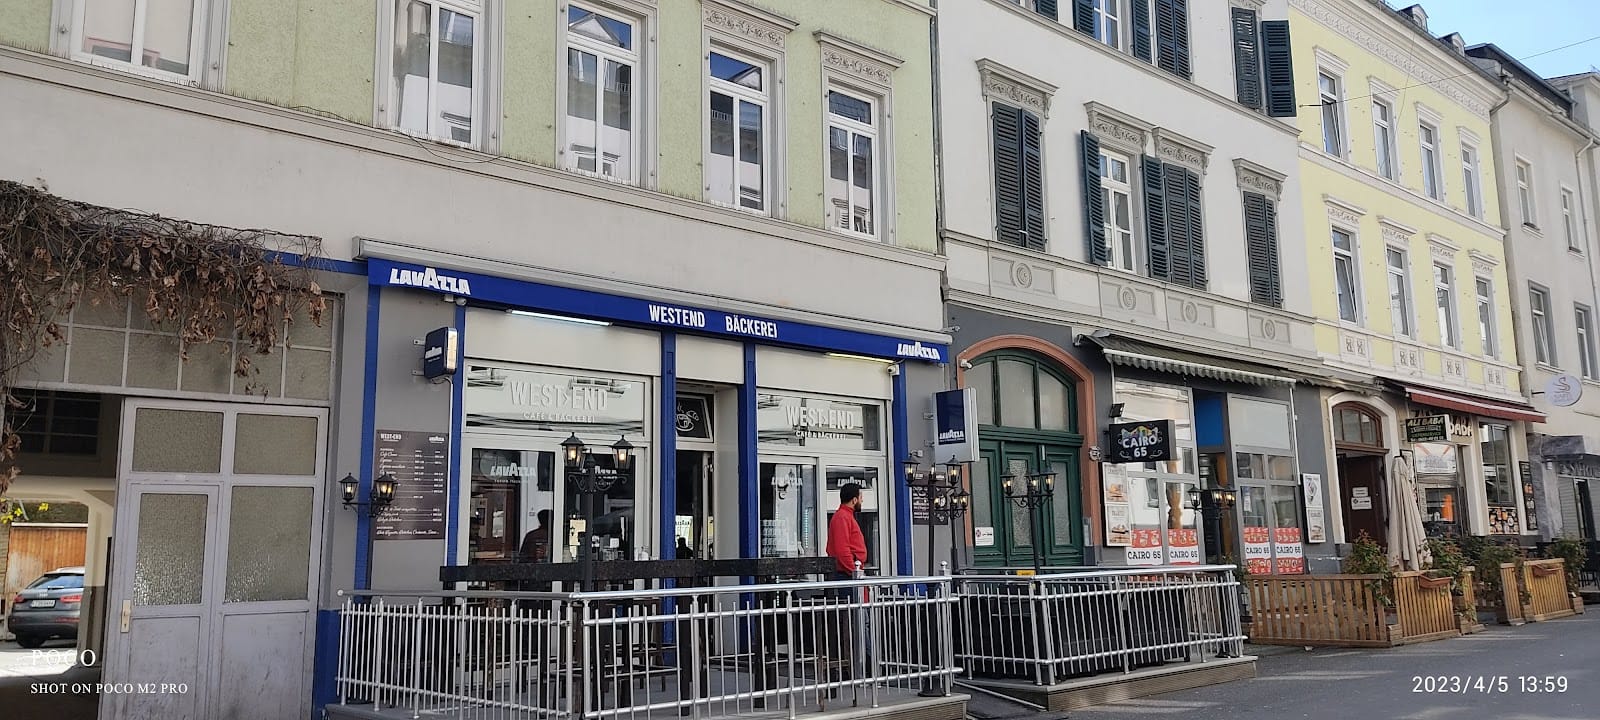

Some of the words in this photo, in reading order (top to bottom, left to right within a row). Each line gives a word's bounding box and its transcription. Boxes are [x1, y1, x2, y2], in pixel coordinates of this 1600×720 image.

[389, 267, 471, 295] LAVAZZA
[648, 304, 705, 328] WESTEND
[725, 315, 778, 338] BÄCKEREI
[897, 341, 941, 360] LAVAZZA
[1122, 435, 1158, 448] CAIRO
[1133, 446, 1148, 458] 65
[1127, 551, 1151, 559] CAIRO
[1153, 551, 1161, 559] 65
[1169, 550, 1189, 558] CAIRO
[1191, 550, 1198, 558] 65
